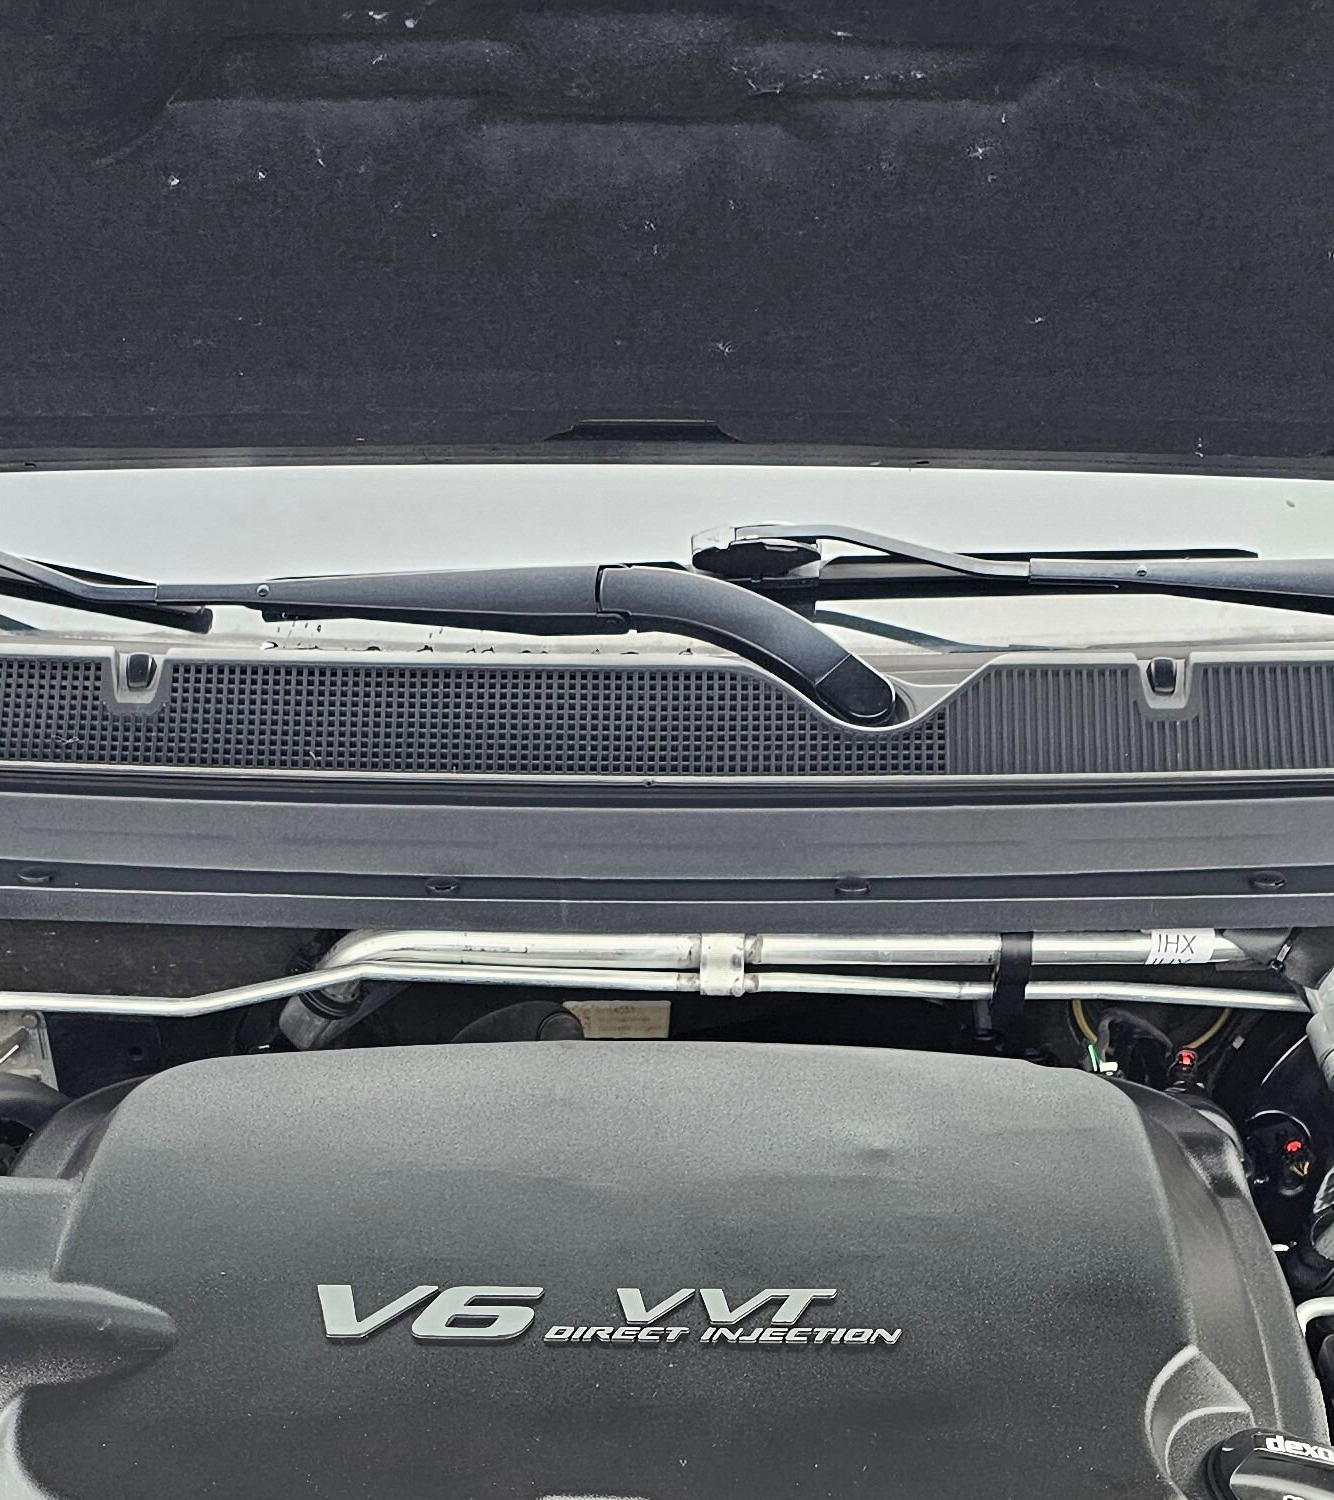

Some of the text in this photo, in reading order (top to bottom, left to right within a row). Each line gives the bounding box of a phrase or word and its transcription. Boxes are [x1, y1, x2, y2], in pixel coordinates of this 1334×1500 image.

[317, 1284, 545, 1339] V6
[617, 1288, 837, 1324] VVT
[543, 1326, 904, 1345] DIRECT INJECTION
